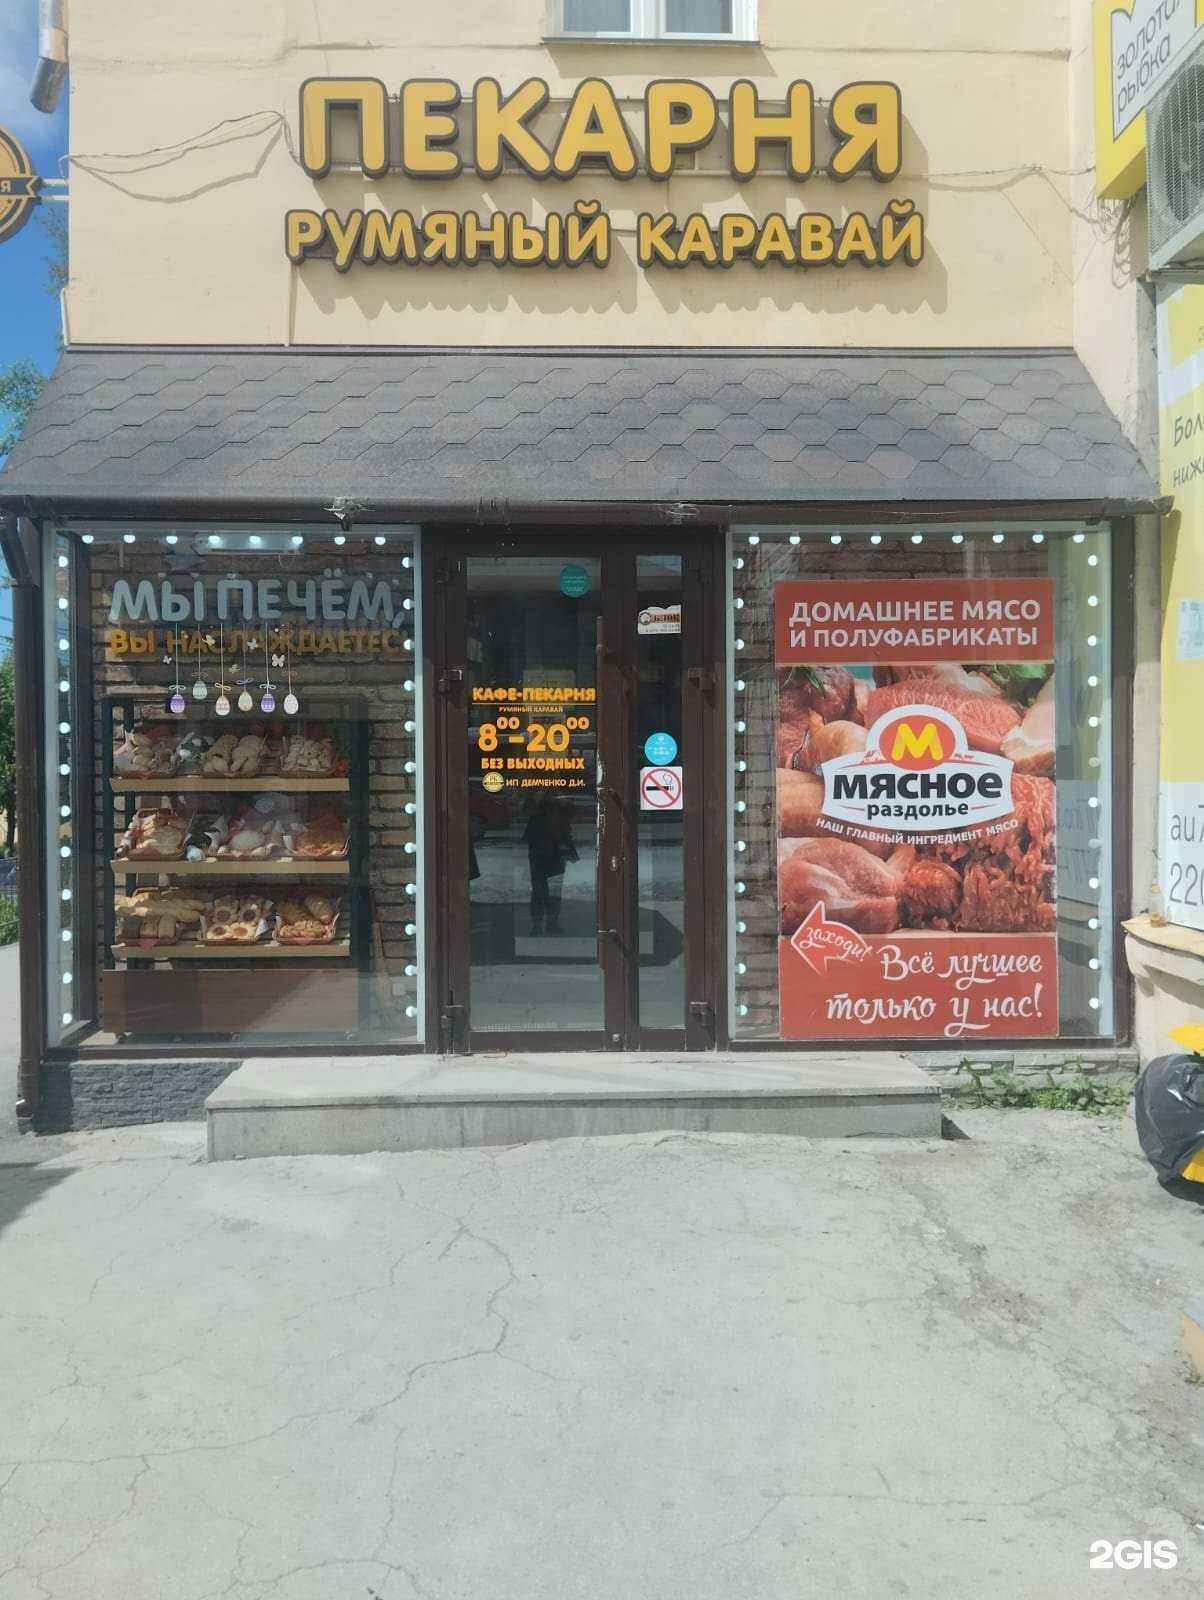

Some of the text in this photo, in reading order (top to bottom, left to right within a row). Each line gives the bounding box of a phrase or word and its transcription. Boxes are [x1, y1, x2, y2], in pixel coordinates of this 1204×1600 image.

[1116, 0, 1181, 80] золота
[1117, 32, 1171, 124] рыбка
[300, 77, 902, 182] ПЕКАРНЯ
[285, 199, 925, 272] РУМЯНЫЙ КАРАВАЙ
[1173, 413, 1204, 448] Бол
[1173, 455, 1204, 489] ниж
[108, 567, 405, 629] МЫ ПЕЧЁМ,
[788, 599, 1041, 627] ДОМАШНЕЕ МЯСО
[110, 628, 155, 654] ВЫ
[789, 626, 1038, 649] И ПОЛУФАБРИКАТЫ
[472, 687, 596, 701] КАФЕ-ПЕКАРНЯ
[891, 722, 943, 761] М
[481, 757, 585, 771] БЕЗ ВЫХОДНЫХ
[506, 779, 518, 787] ИП
[521, 779, 566, 788] ДЕМЧЕНКО
[867, 801, 969, 820] раздолье
[815, 817, 1019, 845] НАШ ГЛАВНЫЙ ИНГРЕДИЕНТ МЯСО
[799, 925, 873, 963] заходи!
[878, 945, 1043, 991] Всё лучшее
[826, 982, 1044, 1038] только у нас!
